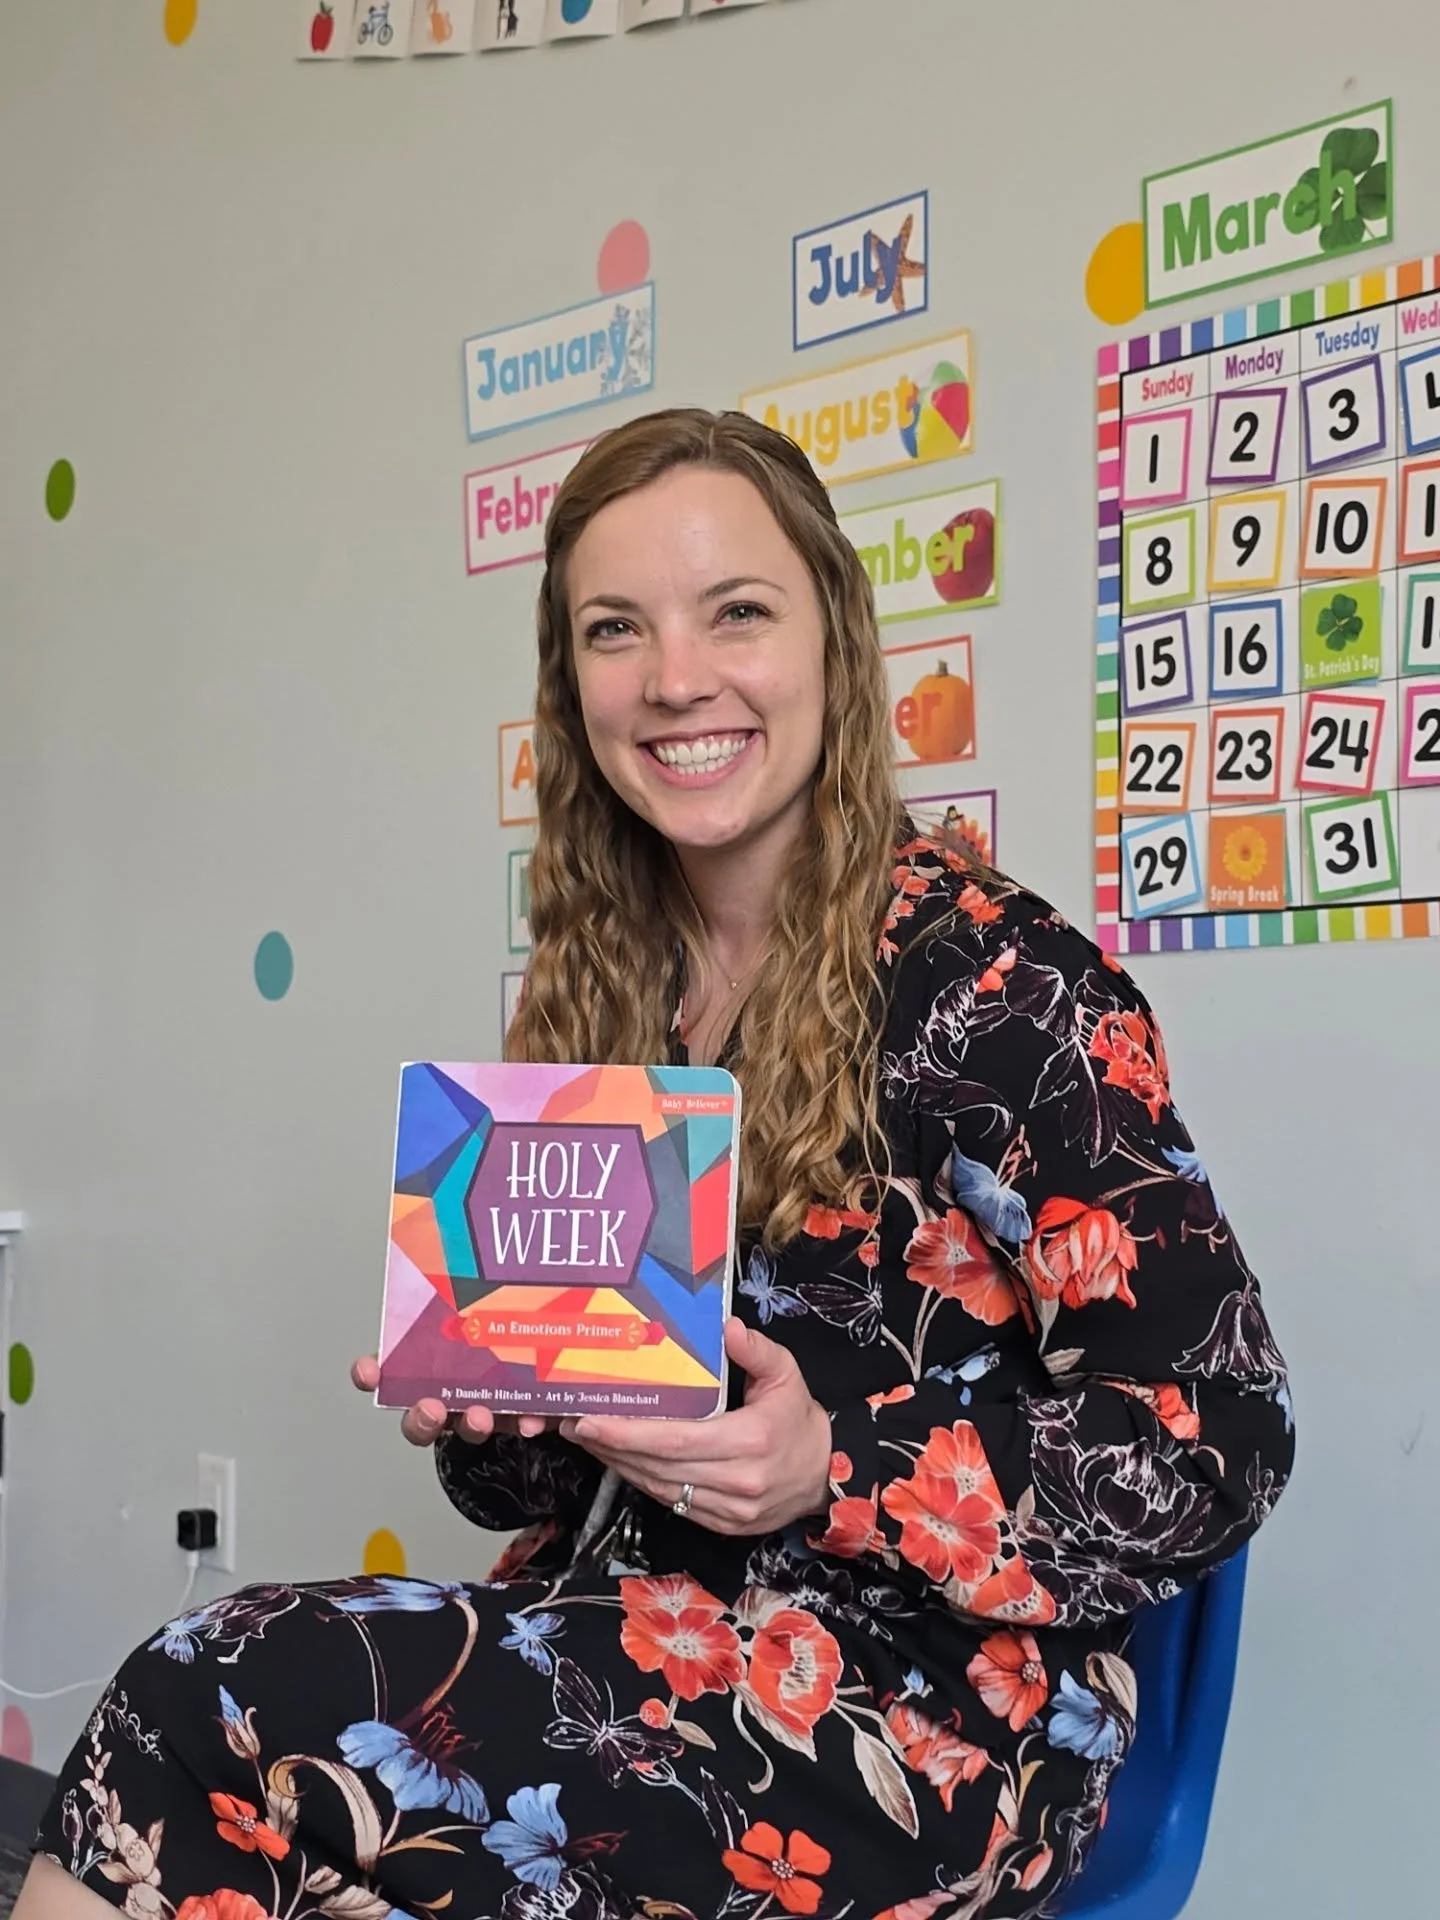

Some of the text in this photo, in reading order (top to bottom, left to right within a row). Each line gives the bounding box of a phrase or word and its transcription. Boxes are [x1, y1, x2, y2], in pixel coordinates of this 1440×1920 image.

[1163, 148, 1357, 272] March
[808, 229, 902, 306] July
[477, 320, 630, 401] January
[1142, 301, 1440, 401] Sunday Monday Tuesday Wed
[1229, 411, 1259, 463] 2
[1328, 388, 1359, 441] 3
[1149, 433, 1159, 483] 1
[477, 475, 559, 540] Febr
[1315, 500, 1368, 555] 10
[857, 518, 975, 586] mber
[1146, 536, 1173, 585] 8
[1232, 515, 1261, 567] 9
[1135, 636, 1177, 691] 15
[1224, 623, 1267, 676] 16
[1320, 655, 1359, 676] Patrick's
[1361, 654, 1379, 674] Day
[1216, 730, 1273, 781] 23
[1305, 717, 1369, 772] 24
[1414, 708, 1440, 762] 2
[1126, 744, 1183, 792] 22
[1133, 836, 1188, 896] 29
[1324, 817, 1378, 874] 31
[1211, 885, 1279, 906] Spring Break
[662, 1098, 682, 1110] Baby
[506, 1140, 621, 1200] HOLY
[489, 1207, 627, 1268] WEEK
[488, 1320, 622, 1337] An Emotions Primer
[441, 1387, 660, 1406] By Danielle Hitchen Art by Jessica Blanchard
